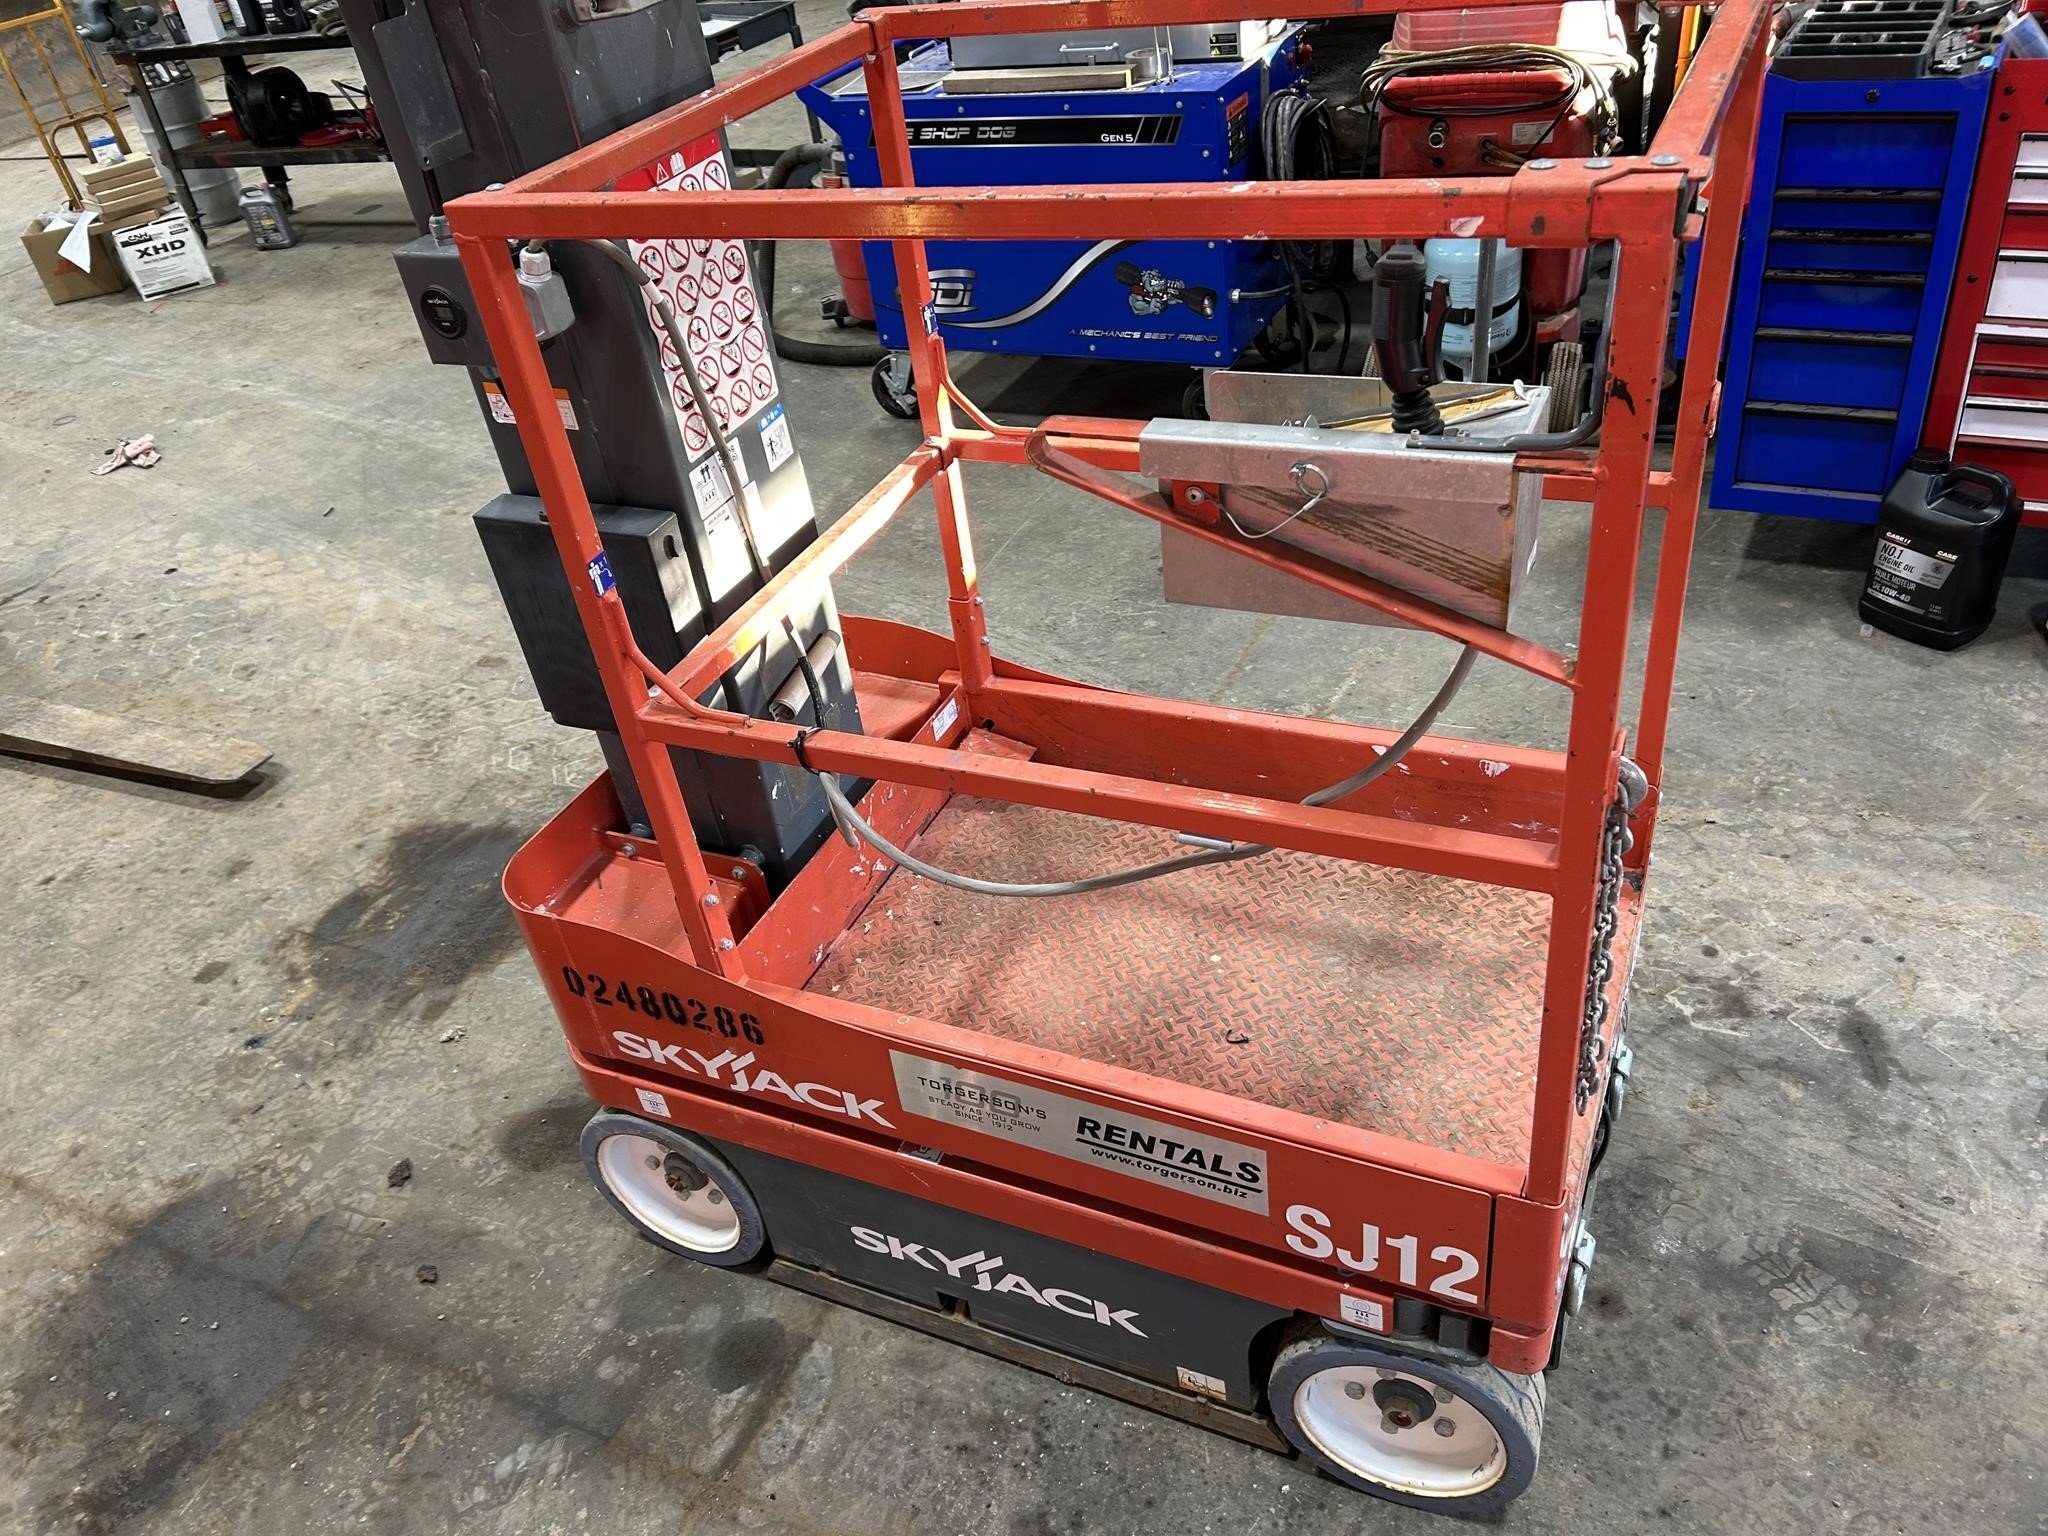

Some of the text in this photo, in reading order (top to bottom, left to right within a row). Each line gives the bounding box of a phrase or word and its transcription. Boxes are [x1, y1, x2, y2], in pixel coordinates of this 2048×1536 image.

[920, 127, 970, 140] SHOP
[976, 126, 1016, 139] DOG
[1125, 133, 1134, 143] 5
[135, 239, 186, 260] XHD
[1079, 329, 1142, 339] MECHANIC'S
[1143, 331, 1175, 340] BEST
[1177, 333, 1219, 342] FRIEND
[1886, 531, 1904, 543] CASE
[1880, 543, 1904, 560] NO.1
[1937, 550, 1959, 560] CASE
[1878, 554, 1904, 569] ENGINE
[1903, 563, 1916, 574] OIL
[1880, 586, 1911, 602] 10W-40
[562, 965, 765, 1046] 02480286
[612, 1030, 897, 1129] SKYJACK
[917, 1076, 1047, 1120] TORGERSON'S
[928, 1096, 1041, 1132] STEADY AS YOU GROW
[955, 1109, 1014, 1132] SINCE 1912
[1076, 1116, 1262, 1184] RENTALS
[1091, 1148, 1249, 1199] www.torgerson.biz
[1285, 1204, 1480, 1305] SJ12
[850, 1226, 1149, 1338] SKYJACK
